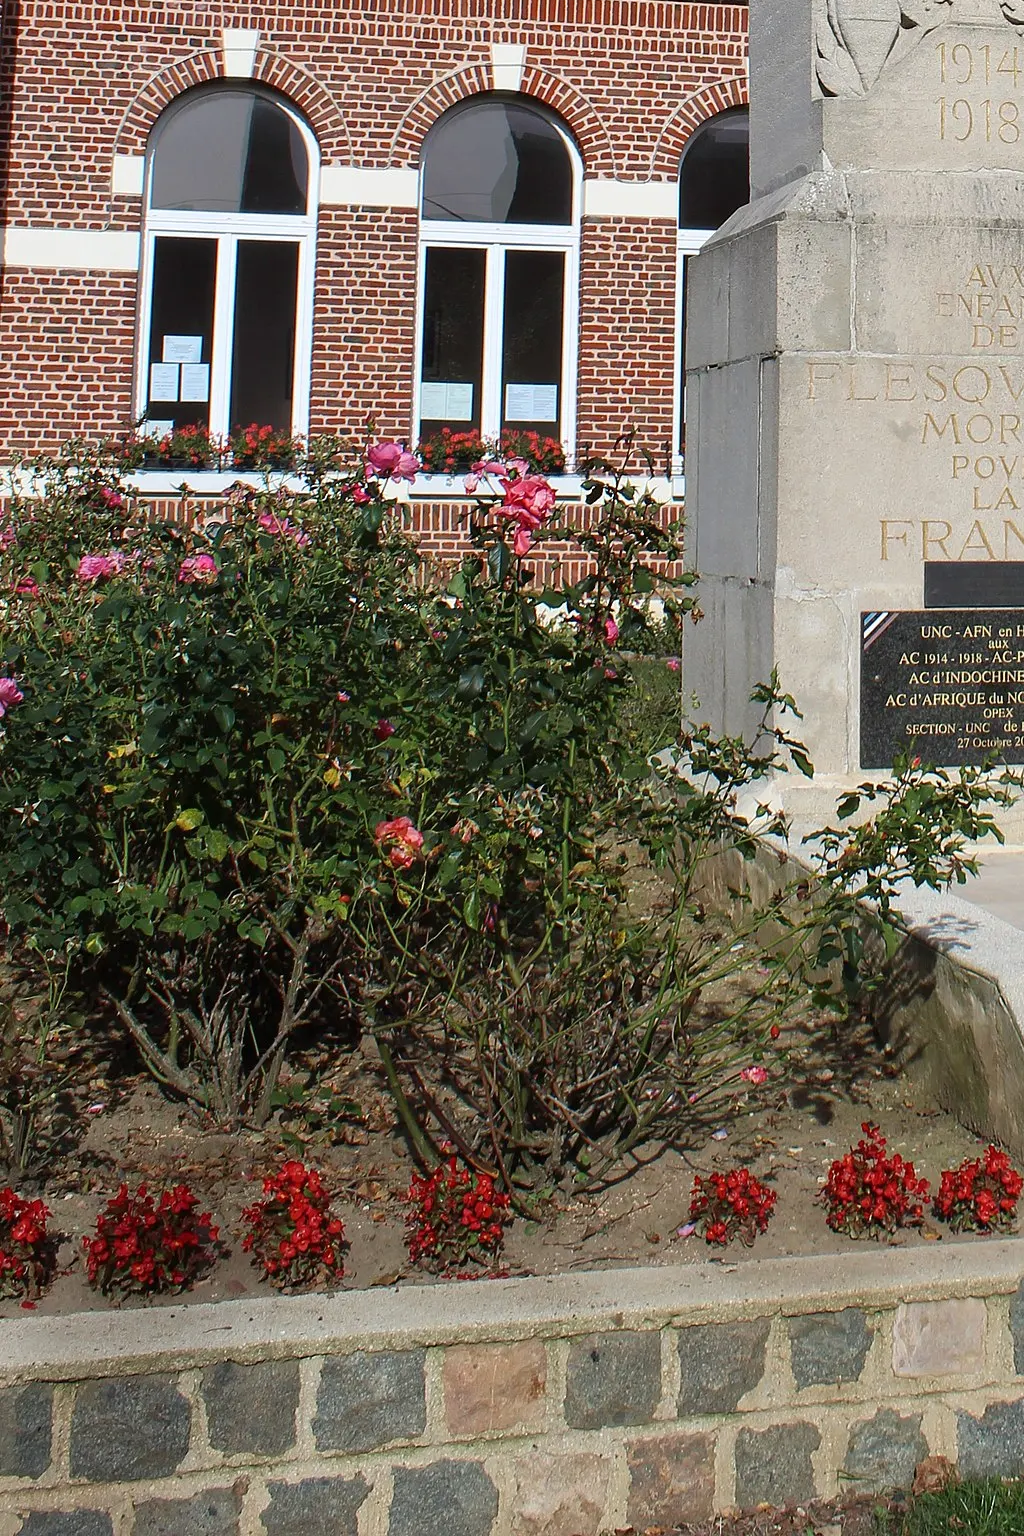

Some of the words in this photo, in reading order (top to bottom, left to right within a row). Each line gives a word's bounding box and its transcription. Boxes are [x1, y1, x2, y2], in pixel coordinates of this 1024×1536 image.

[934, 42, 1022, 88] 1914
[935, 96, 1020, 144] 1918
[971, 325, 1019, 349] DE
[973, 486, 1021, 511] LA
[921, 625, 952, 638] UNC
[963, 625, 993, 638] AFN
[998, 628, 1013, 637] en
[988, 639, 1009, 649] aux
[899, 652, 920, 665] AC
[924, 653, 948, 664] 1914
[959, 653, 983, 664] 1918
[909, 671, 930, 684] AC
[886, 694, 907, 707] AC
[989, 692, 1004, 704] du
[983, 707, 1014, 719] OPEX
[906, 723, 956, 735] SECTION
[965, 722, 991, 734] UNC
[1003, 720, 1018, 732] de
[957, 737, 970, 749] 27
